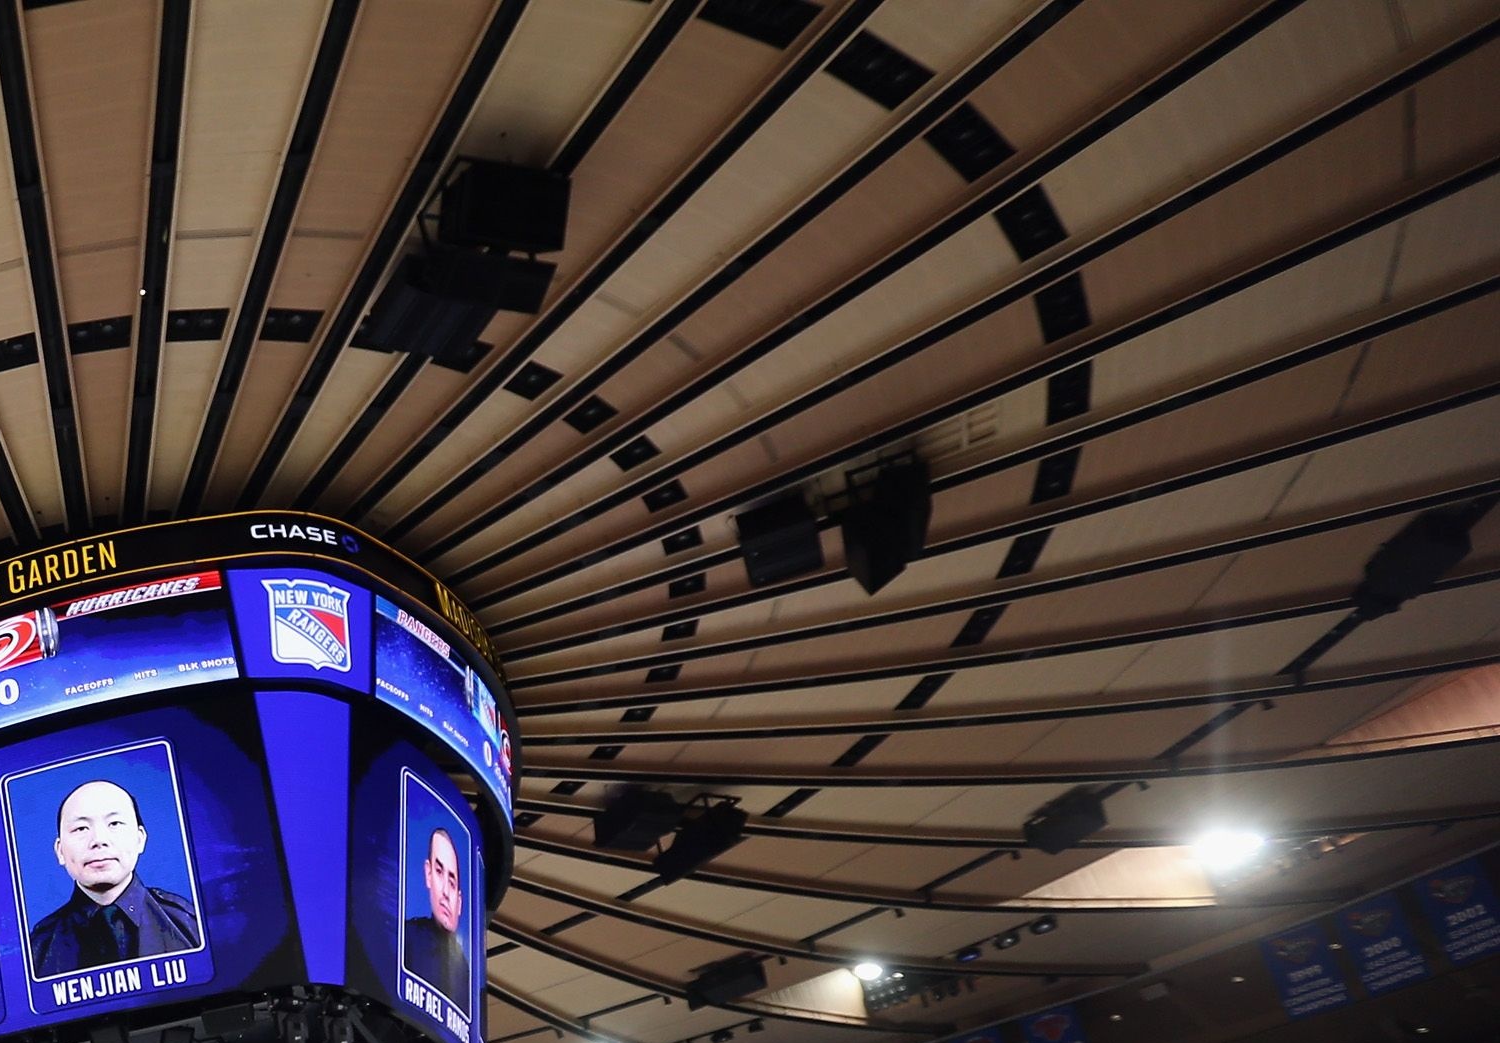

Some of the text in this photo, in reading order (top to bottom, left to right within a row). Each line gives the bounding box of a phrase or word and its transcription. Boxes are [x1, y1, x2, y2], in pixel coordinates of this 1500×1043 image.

[250, 524, 338, 545] CHASE
[8, 540, 117, 594] GARDEN
[65, 577, 200, 618] HURRICANES
[274, 589, 343, 613] NEW YORK
[286, 608, 345, 663] RANGERS
[397, 609, 450, 659] RANGERS
[134, 669, 158, 680] HITS
[178, 656, 235, 673] BLK SHOTS
[64, 677, 114, 696] FACEOFFS
[376, 678, 410, 702] FACEOFFS
[52, 958, 187, 1006] WENJIAN LIU
[405, 978, 444, 1023] RAFAEL
